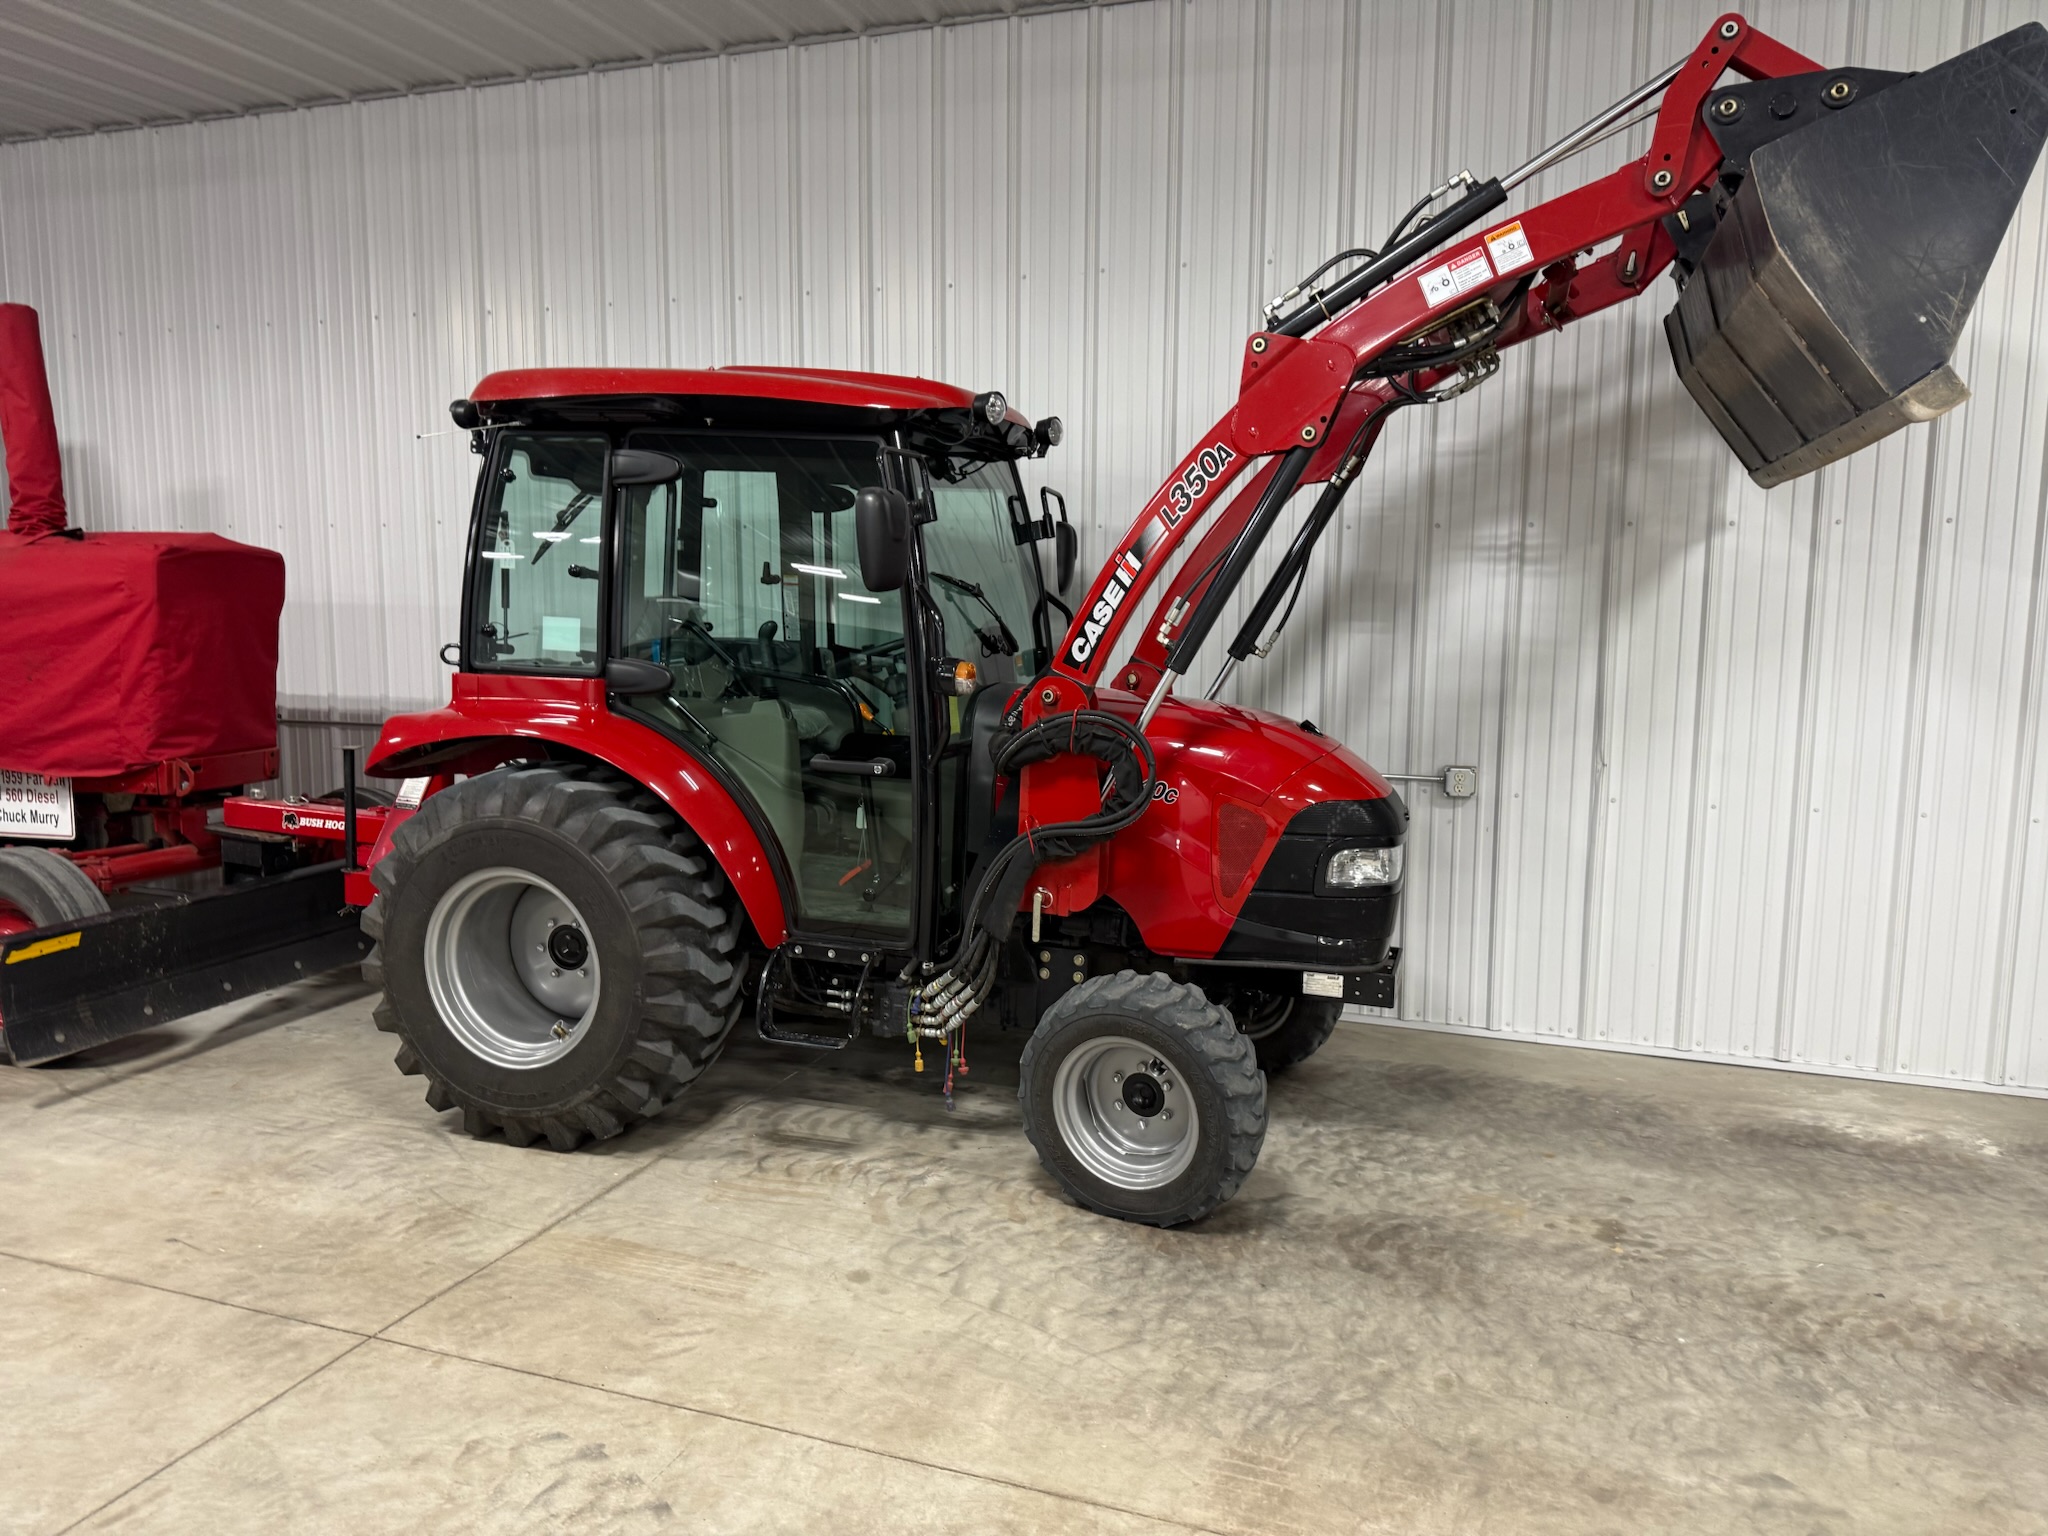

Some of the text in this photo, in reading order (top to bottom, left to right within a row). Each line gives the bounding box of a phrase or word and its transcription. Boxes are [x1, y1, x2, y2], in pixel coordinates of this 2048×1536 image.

[1456, 251, 1481, 266] DANGER
[1160, 442, 1235, 530] L350A
[1, 770, 65, 786] 1959 Farall
[5, 788, 23, 802] 560
[26, 788, 60, 805] Diesel
[30, 809, 60, 828] Murry
[299, 817, 345, 830] BUSH HOG
